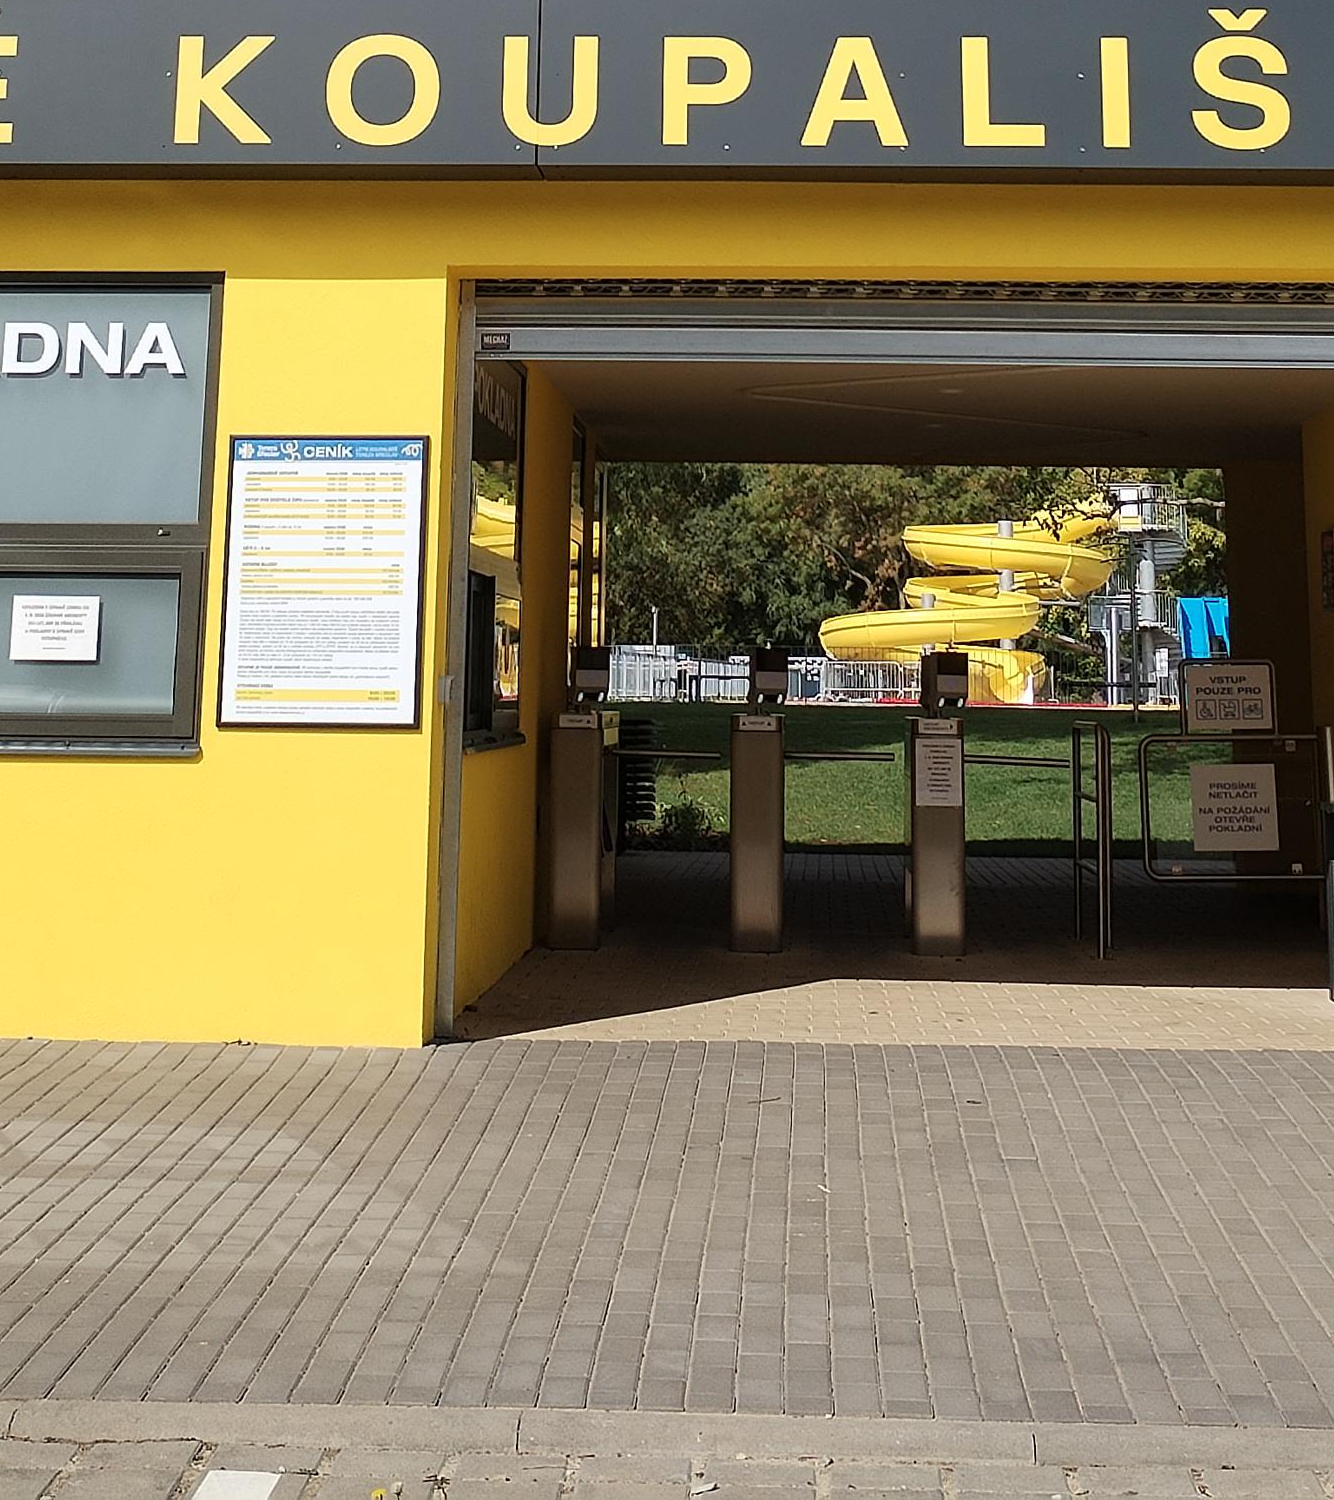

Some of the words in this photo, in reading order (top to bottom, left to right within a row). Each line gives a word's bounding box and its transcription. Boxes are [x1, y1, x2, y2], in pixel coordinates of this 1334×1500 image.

[303, 443, 353, 458] CENÍK
[1209, 676, 1247, 684] VSTUP
[1195, 686, 1234, 695] POUZE
[1237, 686, 1262, 695] PRO
[1209, 781, 1257, 790] PROSÍME
[1208, 790, 1258, 799] NETLAČIT
[1198, 807, 1214, 815] NA
[1216, 804, 1271, 815] POŽÁDÁNÍ
[1214, 814, 1255, 824] OTEVŘE
[1208, 823, 1263, 833] POKLADNÍ
